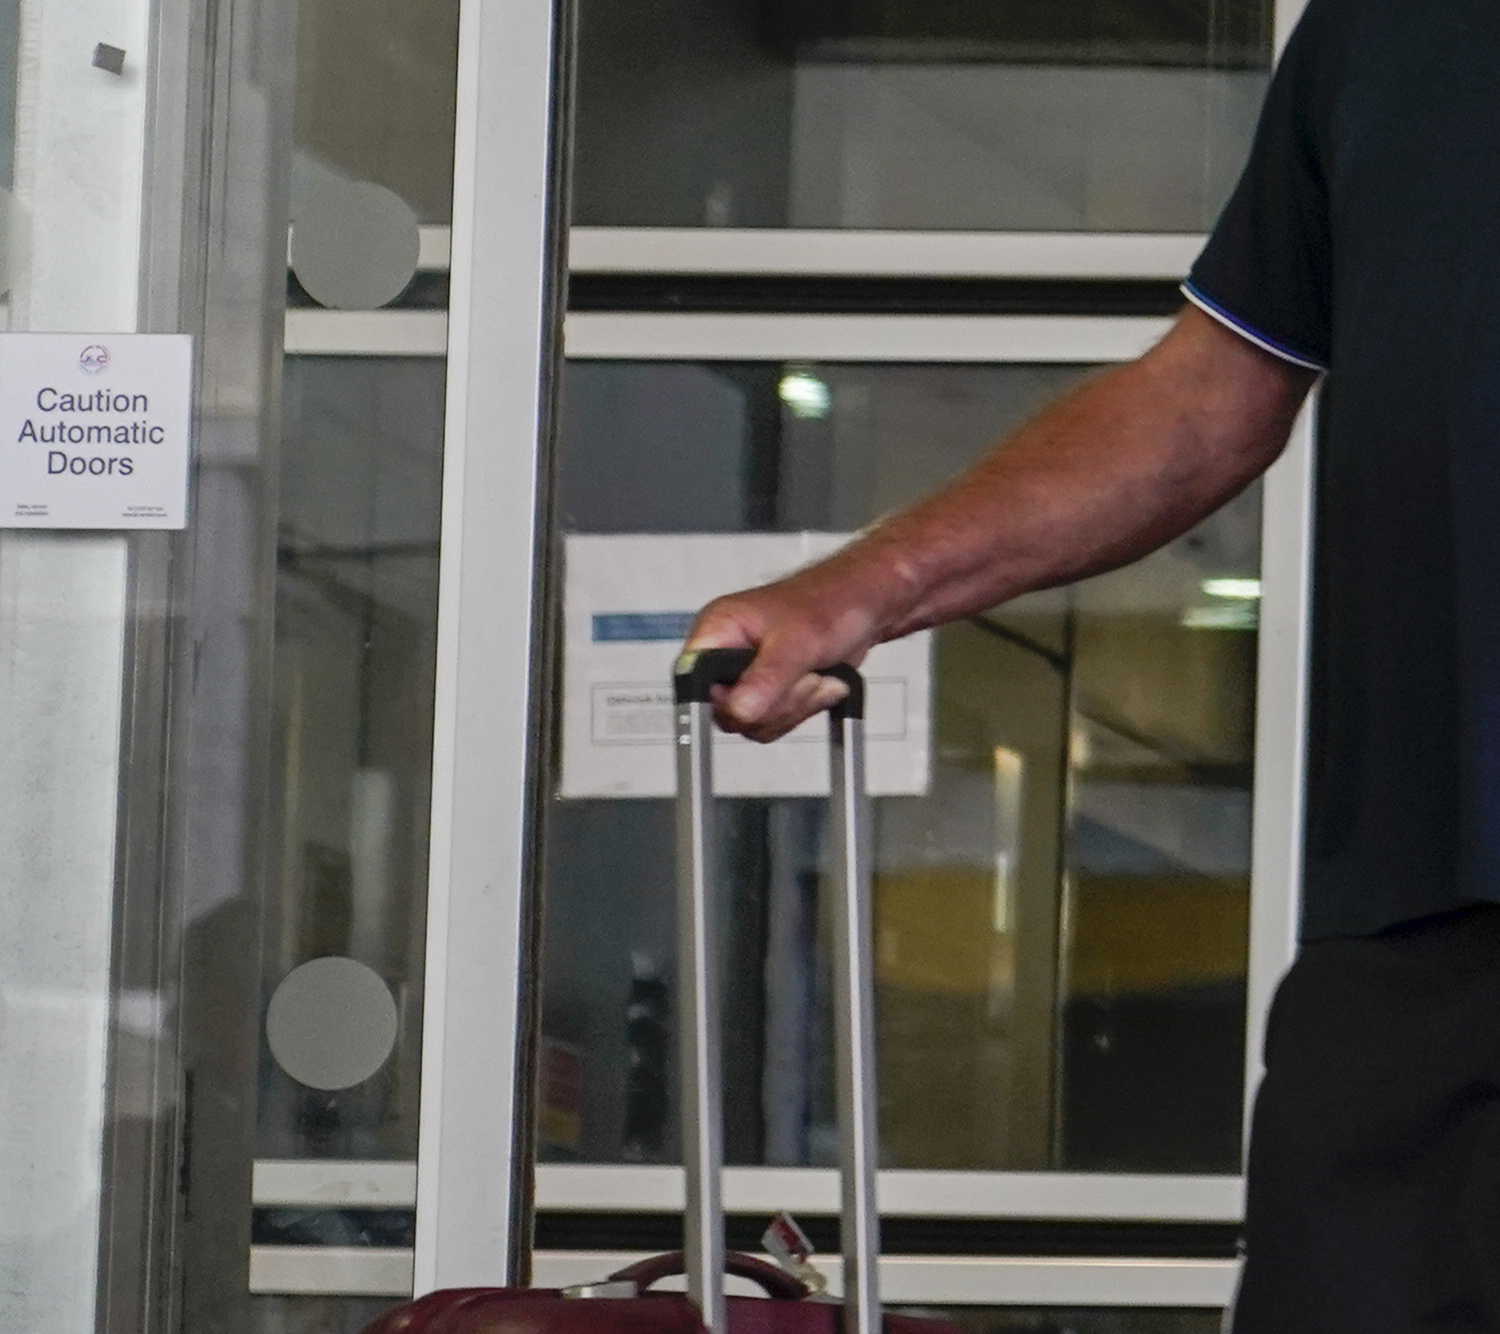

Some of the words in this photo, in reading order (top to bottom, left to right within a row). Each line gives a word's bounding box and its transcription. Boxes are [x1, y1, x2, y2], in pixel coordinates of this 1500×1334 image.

[36, 387, 148, 412] Caution
[18, 419, 165, 445] Automatic
[47, 450, 134, 475] Doors
